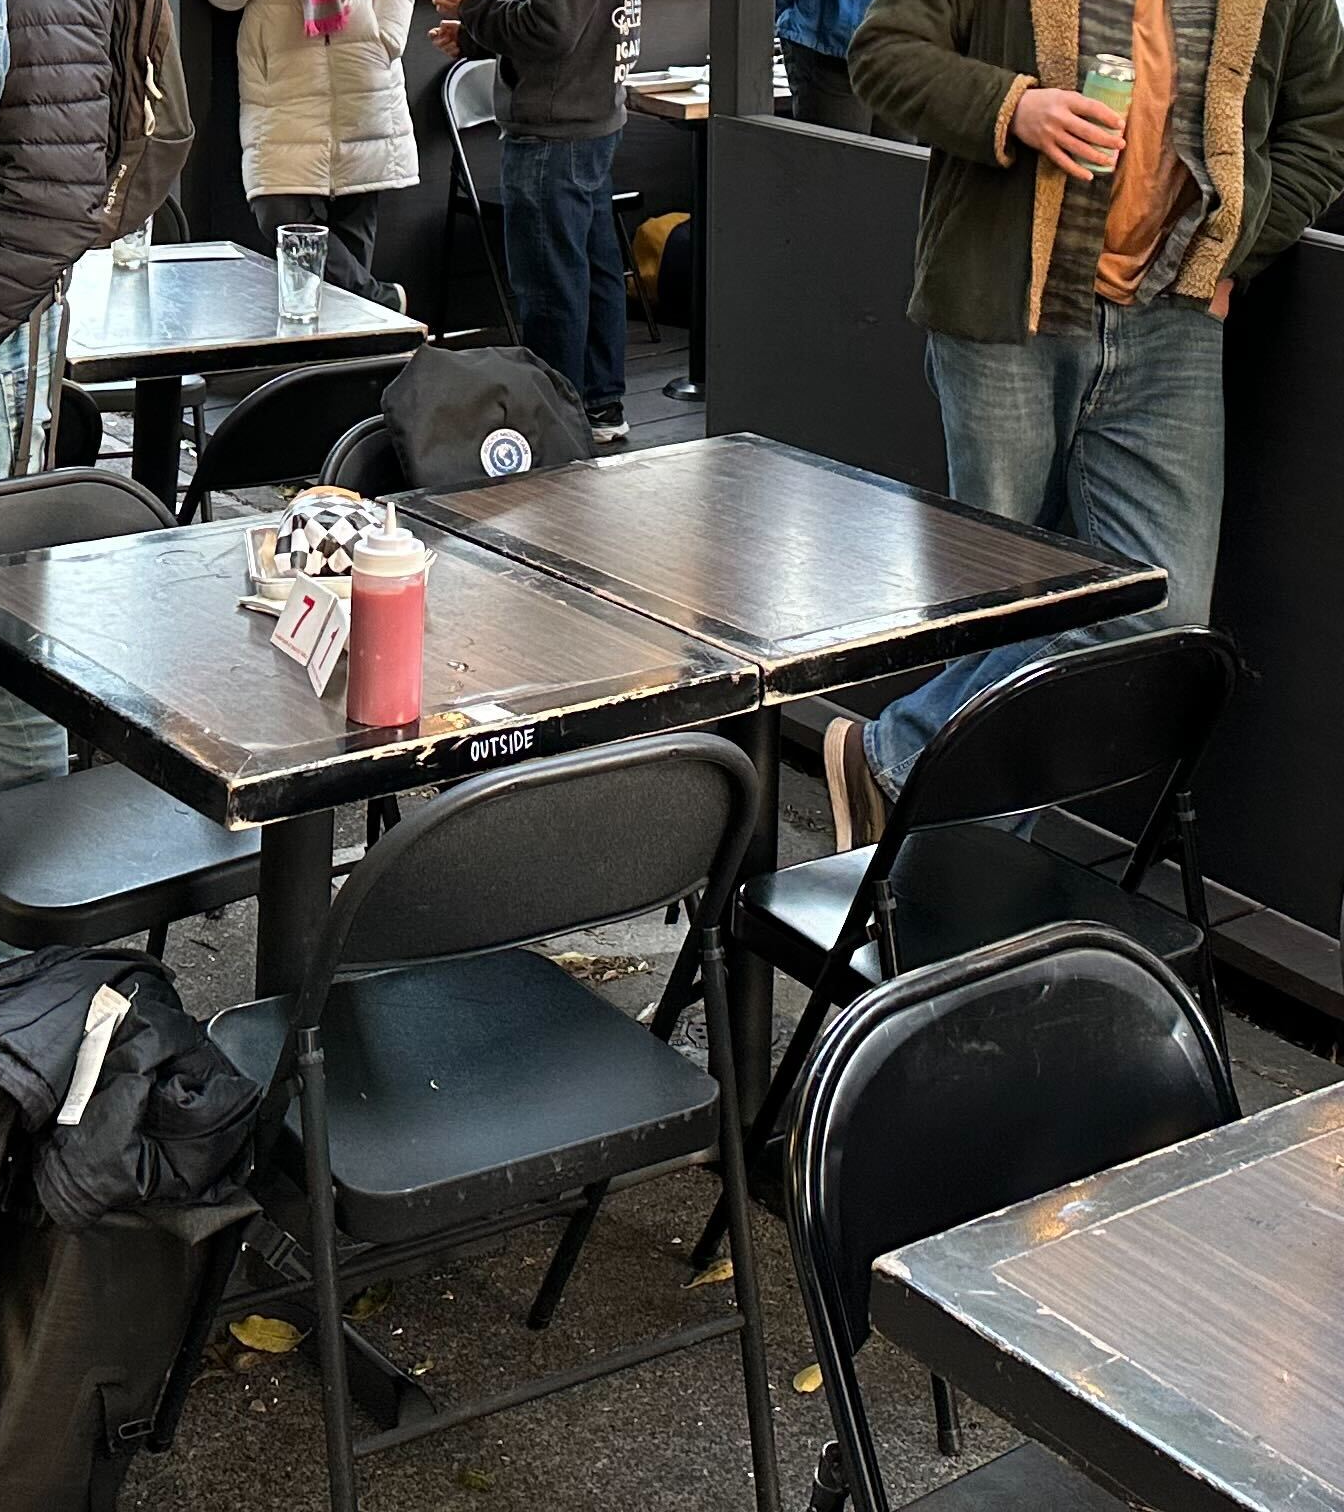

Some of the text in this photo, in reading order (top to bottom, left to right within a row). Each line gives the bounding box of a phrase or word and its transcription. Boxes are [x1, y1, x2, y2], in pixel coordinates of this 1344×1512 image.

[290, 594, 316, 639] 7
[318, 627, 340, 671] 1
[470, 727, 536, 762] OUTSIDE
